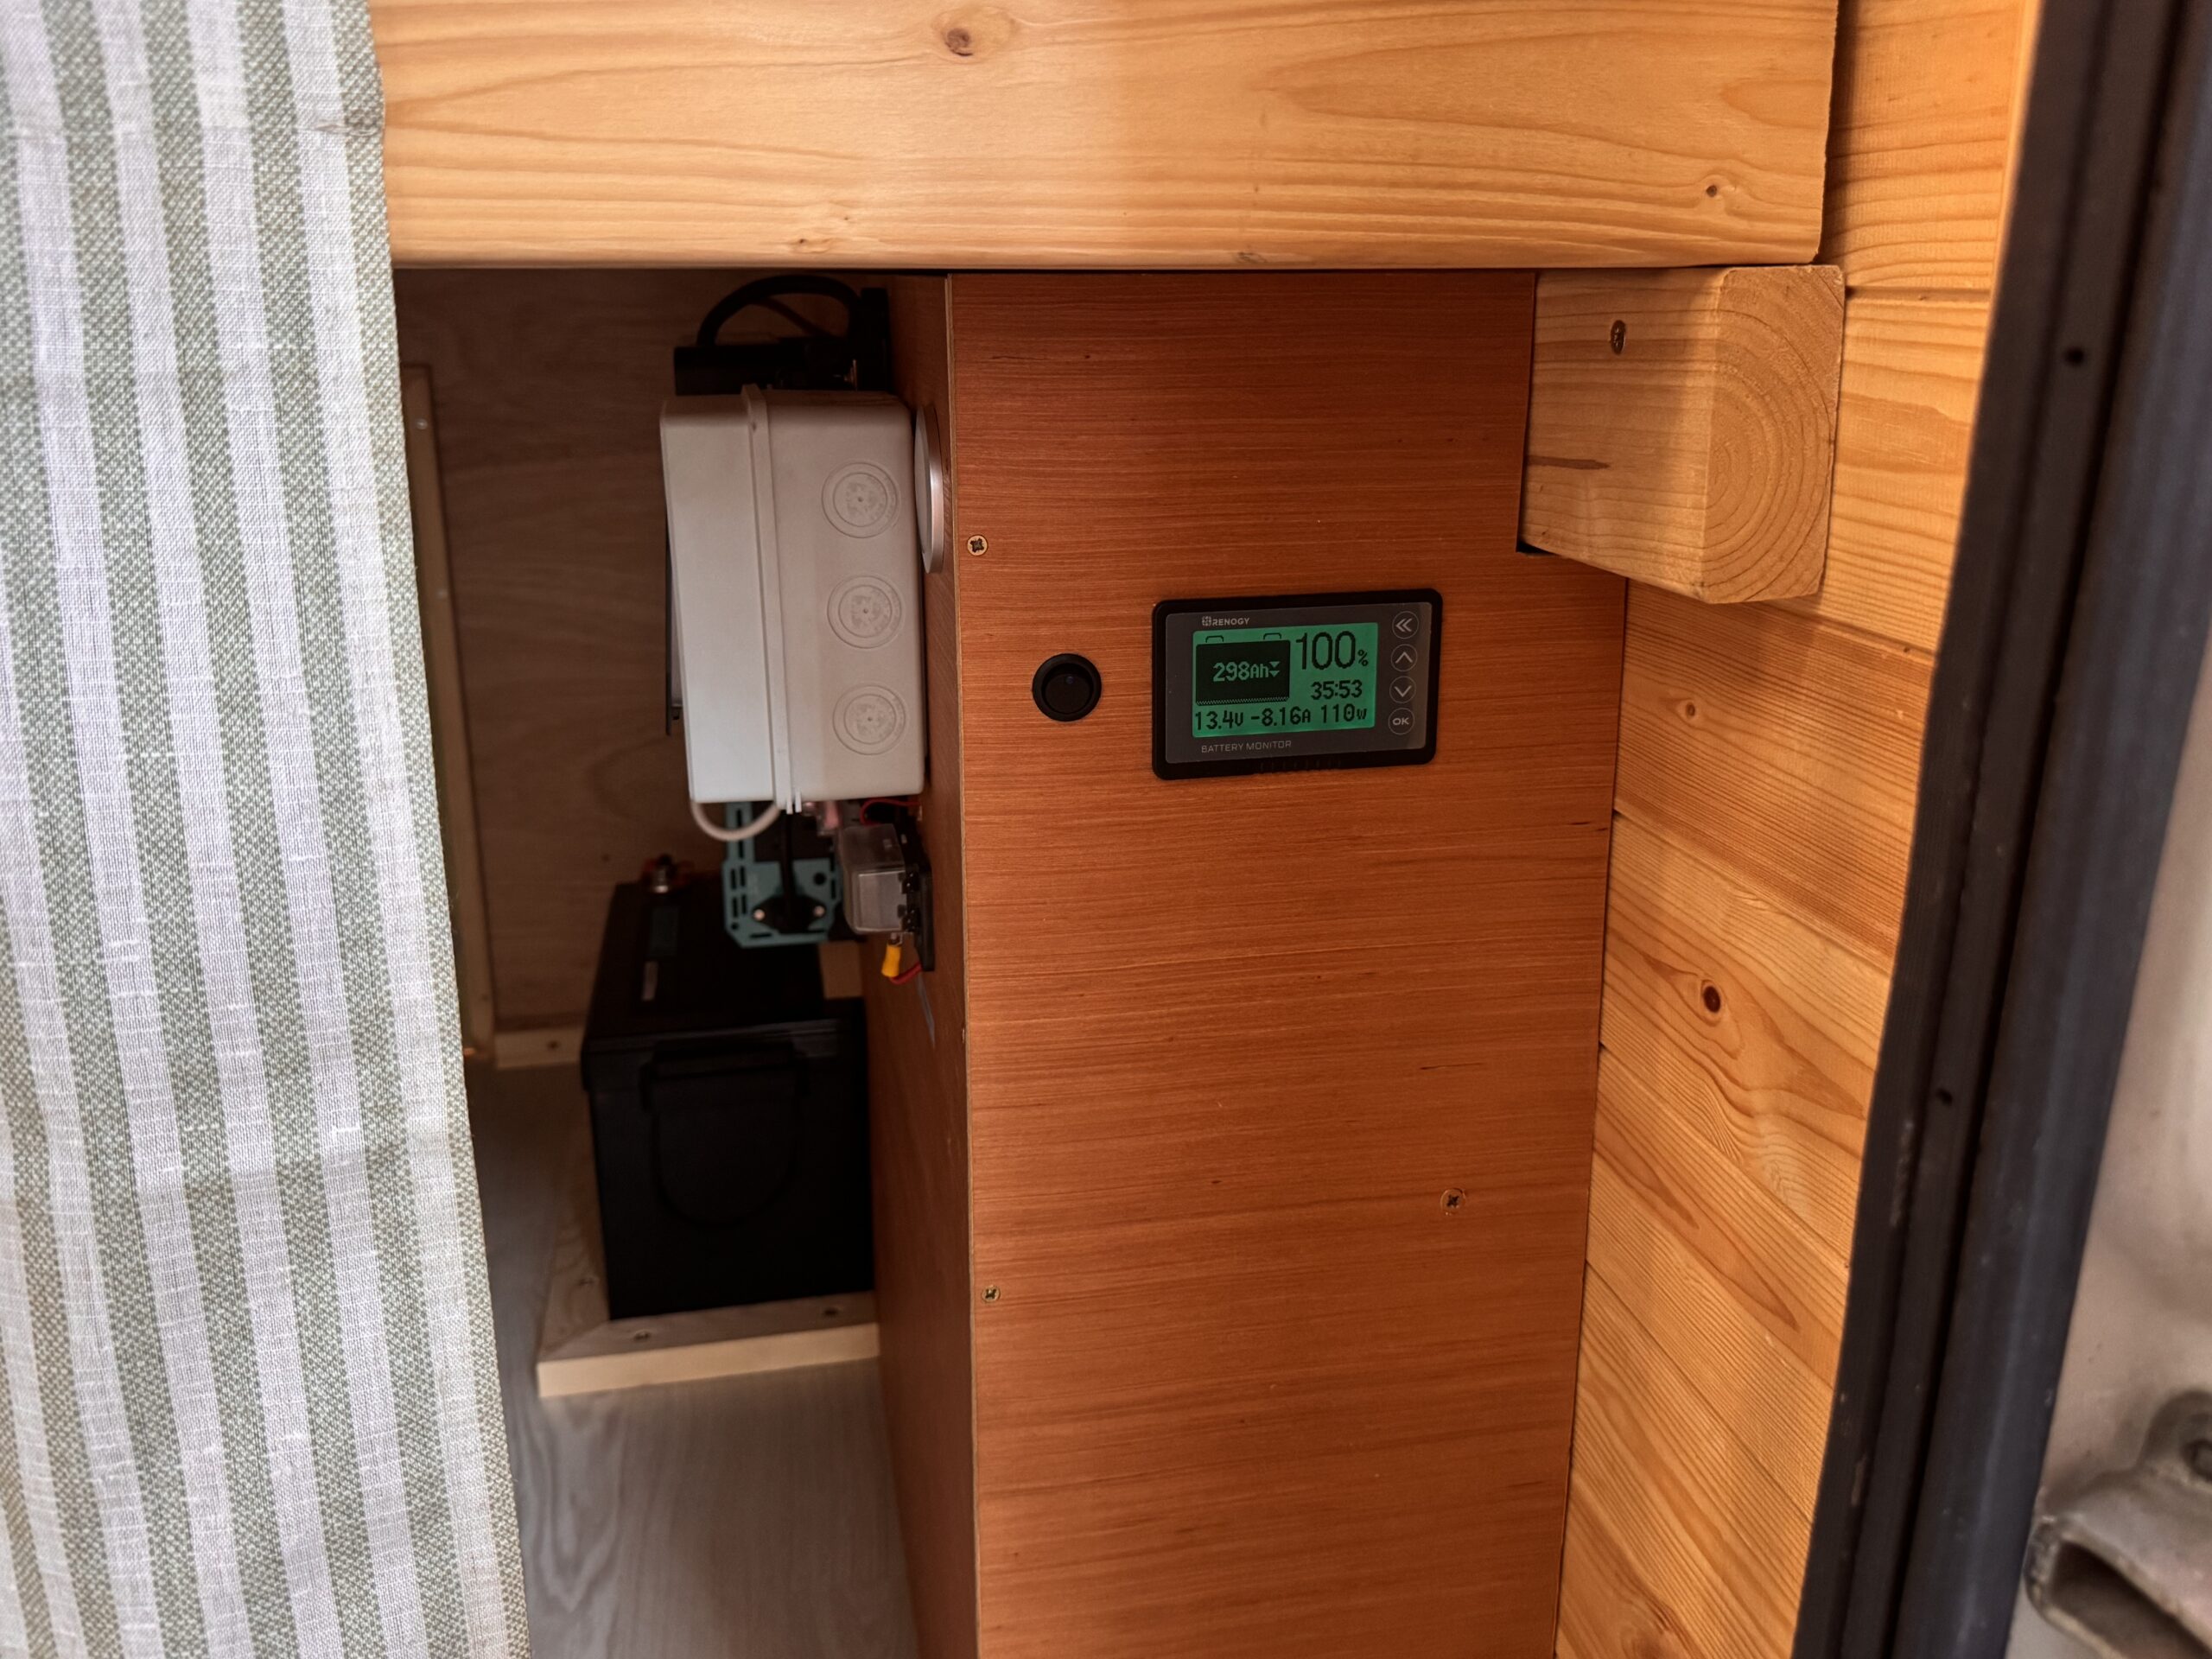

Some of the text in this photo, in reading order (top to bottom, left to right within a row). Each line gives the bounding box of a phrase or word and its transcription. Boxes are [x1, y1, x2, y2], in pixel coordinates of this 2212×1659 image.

[1211, 616, 1250, 626] RENOGY
[1295, 631, 1369, 670] 100%
[1212, 660, 1270, 682] 298Ah
[1310, 679, 1363, 701] 35:53
[1250, 706, 1311, 727] -8.16A
[1392, 716, 1409, 726] OK
[1200, 740, 1292, 753] BATTERY MONITOR
